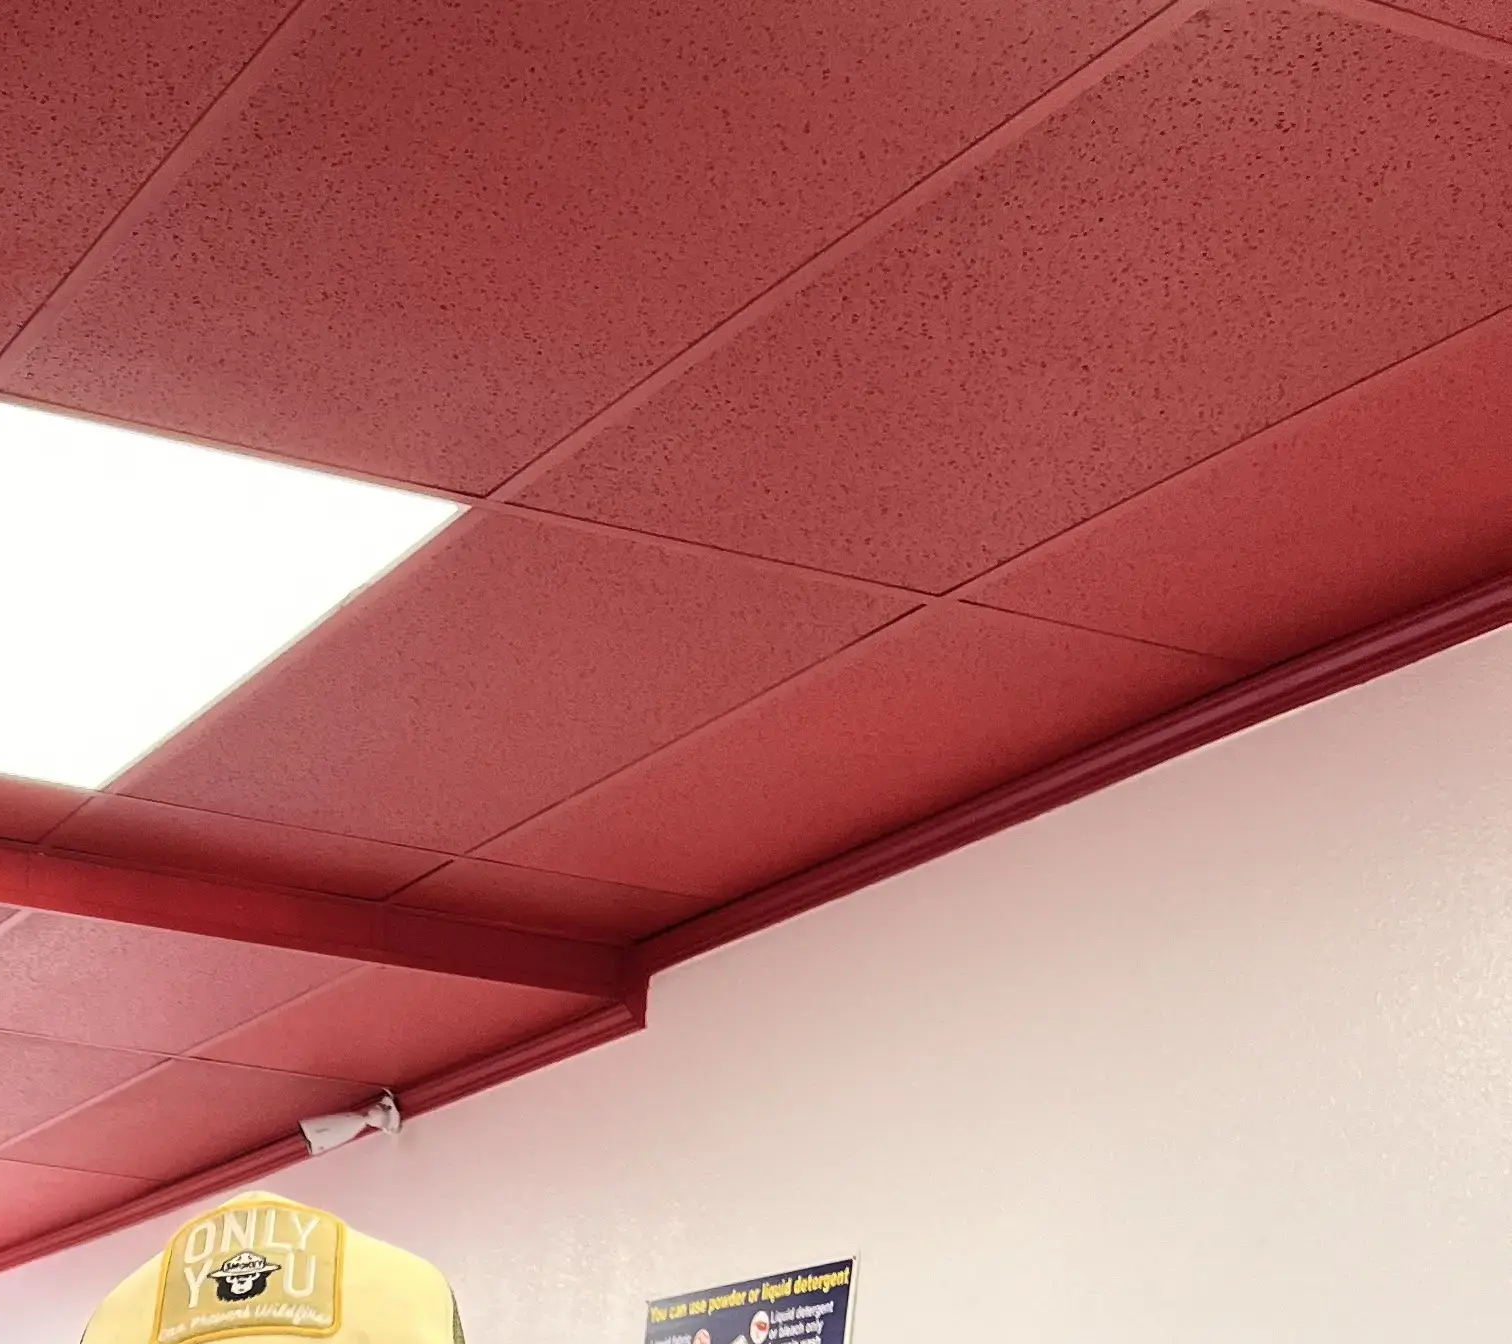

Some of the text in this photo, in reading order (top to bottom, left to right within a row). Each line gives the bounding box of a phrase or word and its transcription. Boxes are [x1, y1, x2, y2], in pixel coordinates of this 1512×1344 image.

[184, 1208, 320, 1264] ONLY
[650, 1266, 849, 1323] You can use powder or liquid detergent
[796, 1301, 833, 1319] detergent
